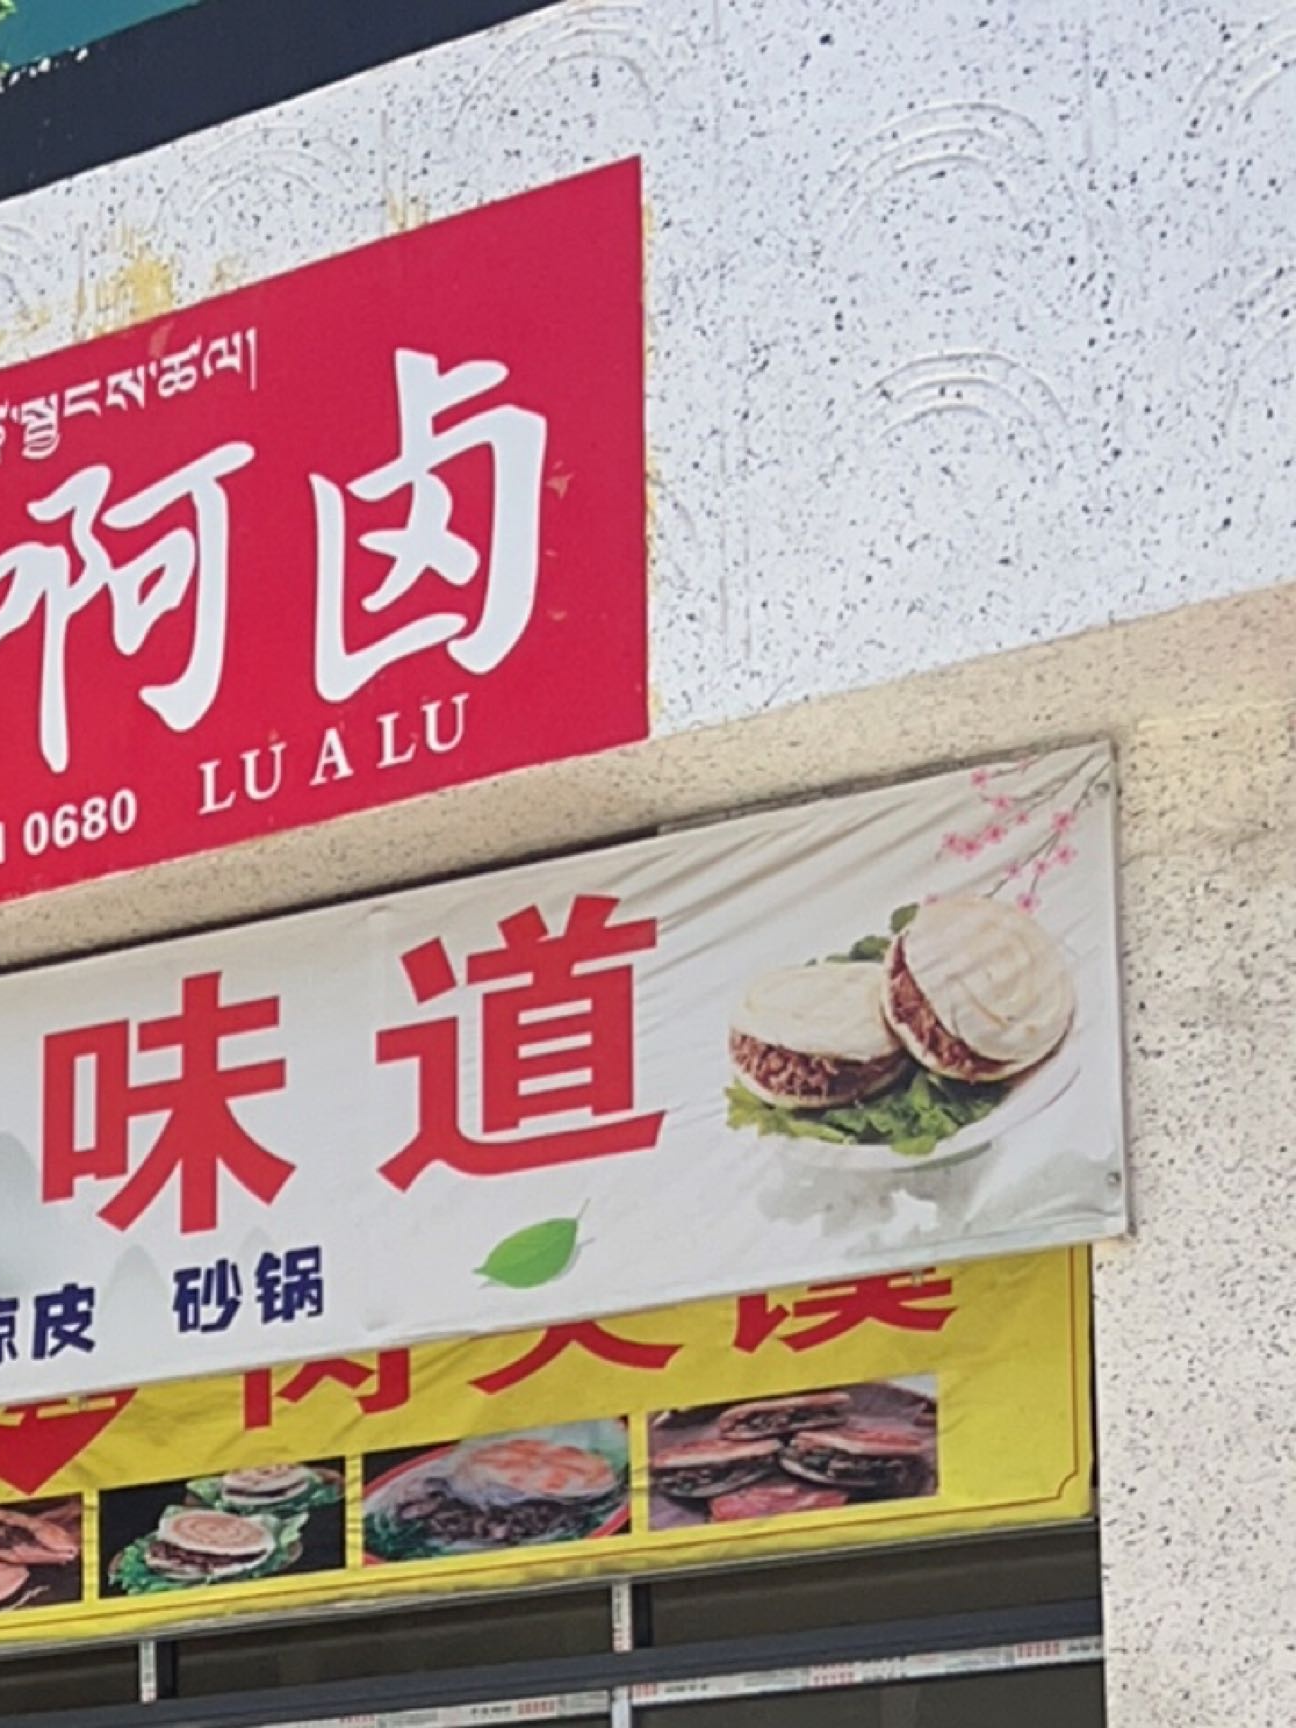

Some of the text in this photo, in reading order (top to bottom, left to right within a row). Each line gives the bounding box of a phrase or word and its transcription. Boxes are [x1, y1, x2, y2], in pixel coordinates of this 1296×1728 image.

[200, 693, 469, 815] LU A LU
[23, 789, 138, 851] 0680
[172, 1246, 325, 1334] 砂锅
